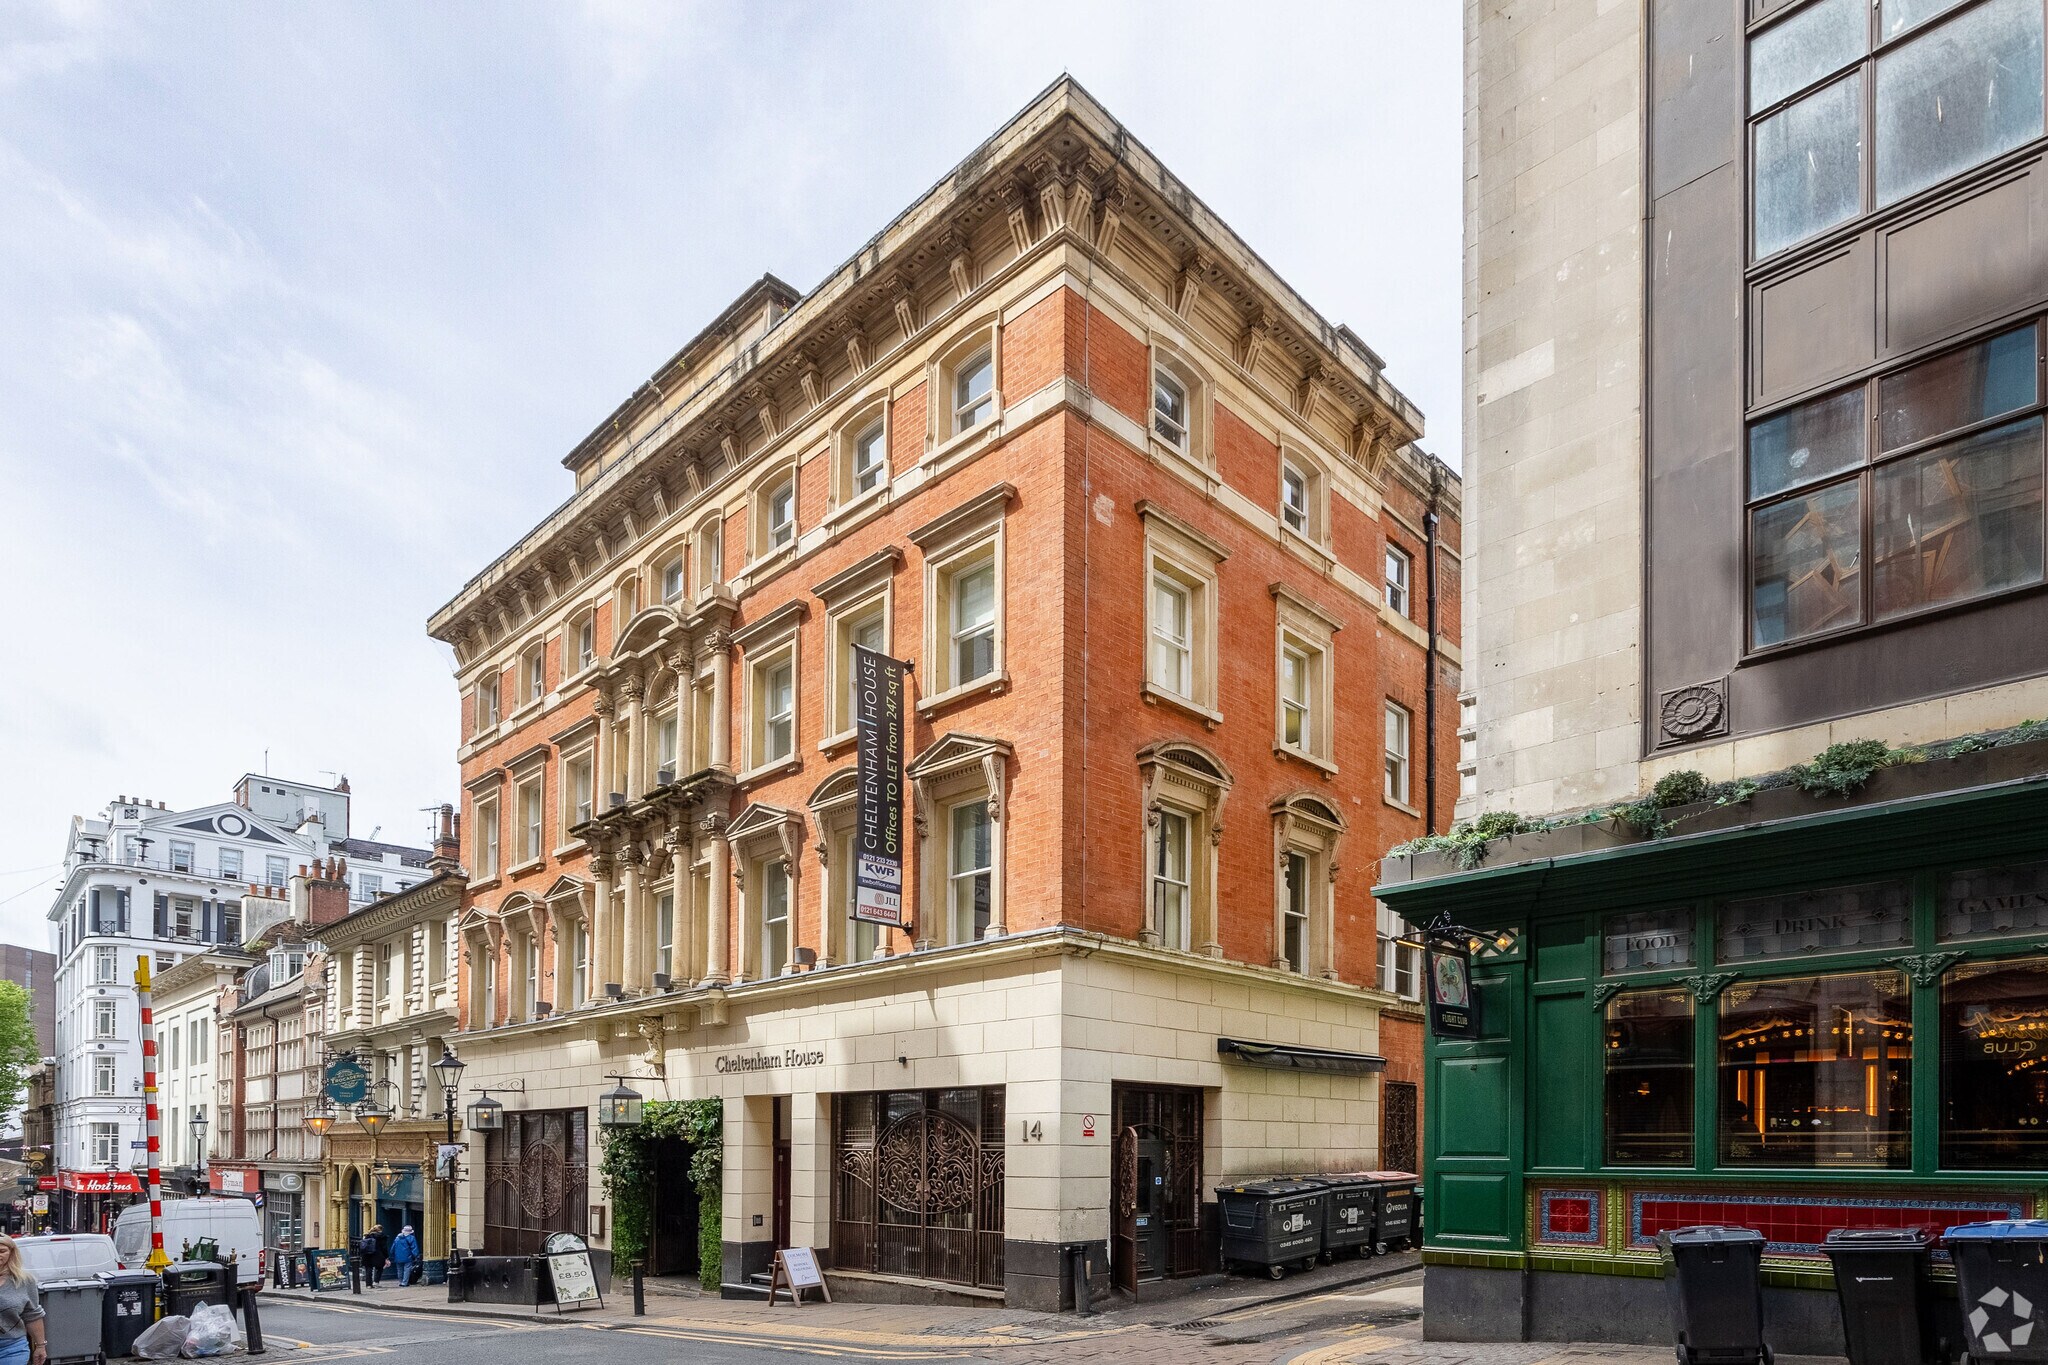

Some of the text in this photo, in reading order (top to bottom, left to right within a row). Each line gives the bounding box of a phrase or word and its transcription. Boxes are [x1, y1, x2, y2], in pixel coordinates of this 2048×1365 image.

[863, 656, 878, 849] CHELTENHAM HOUSE
[884, 665, 900, 854] Offices TO LET from 247 sq ft
[865, 862, 895, 877] KWB
[885, 896, 898, 907] JLL
[1775, 915, 1847, 934] DRINK
[1626, 935, 1679, 951] FOOD
[1441, 1013, 1468, 1026] FLIGHT CLUB
[715, 1049, 824, 1074] Cheltenham House
[1022, 1119, 1043, 1143] 14
[287, 1176, 296, 1186] E
[558, 1270, 587, 1280] £8.50
